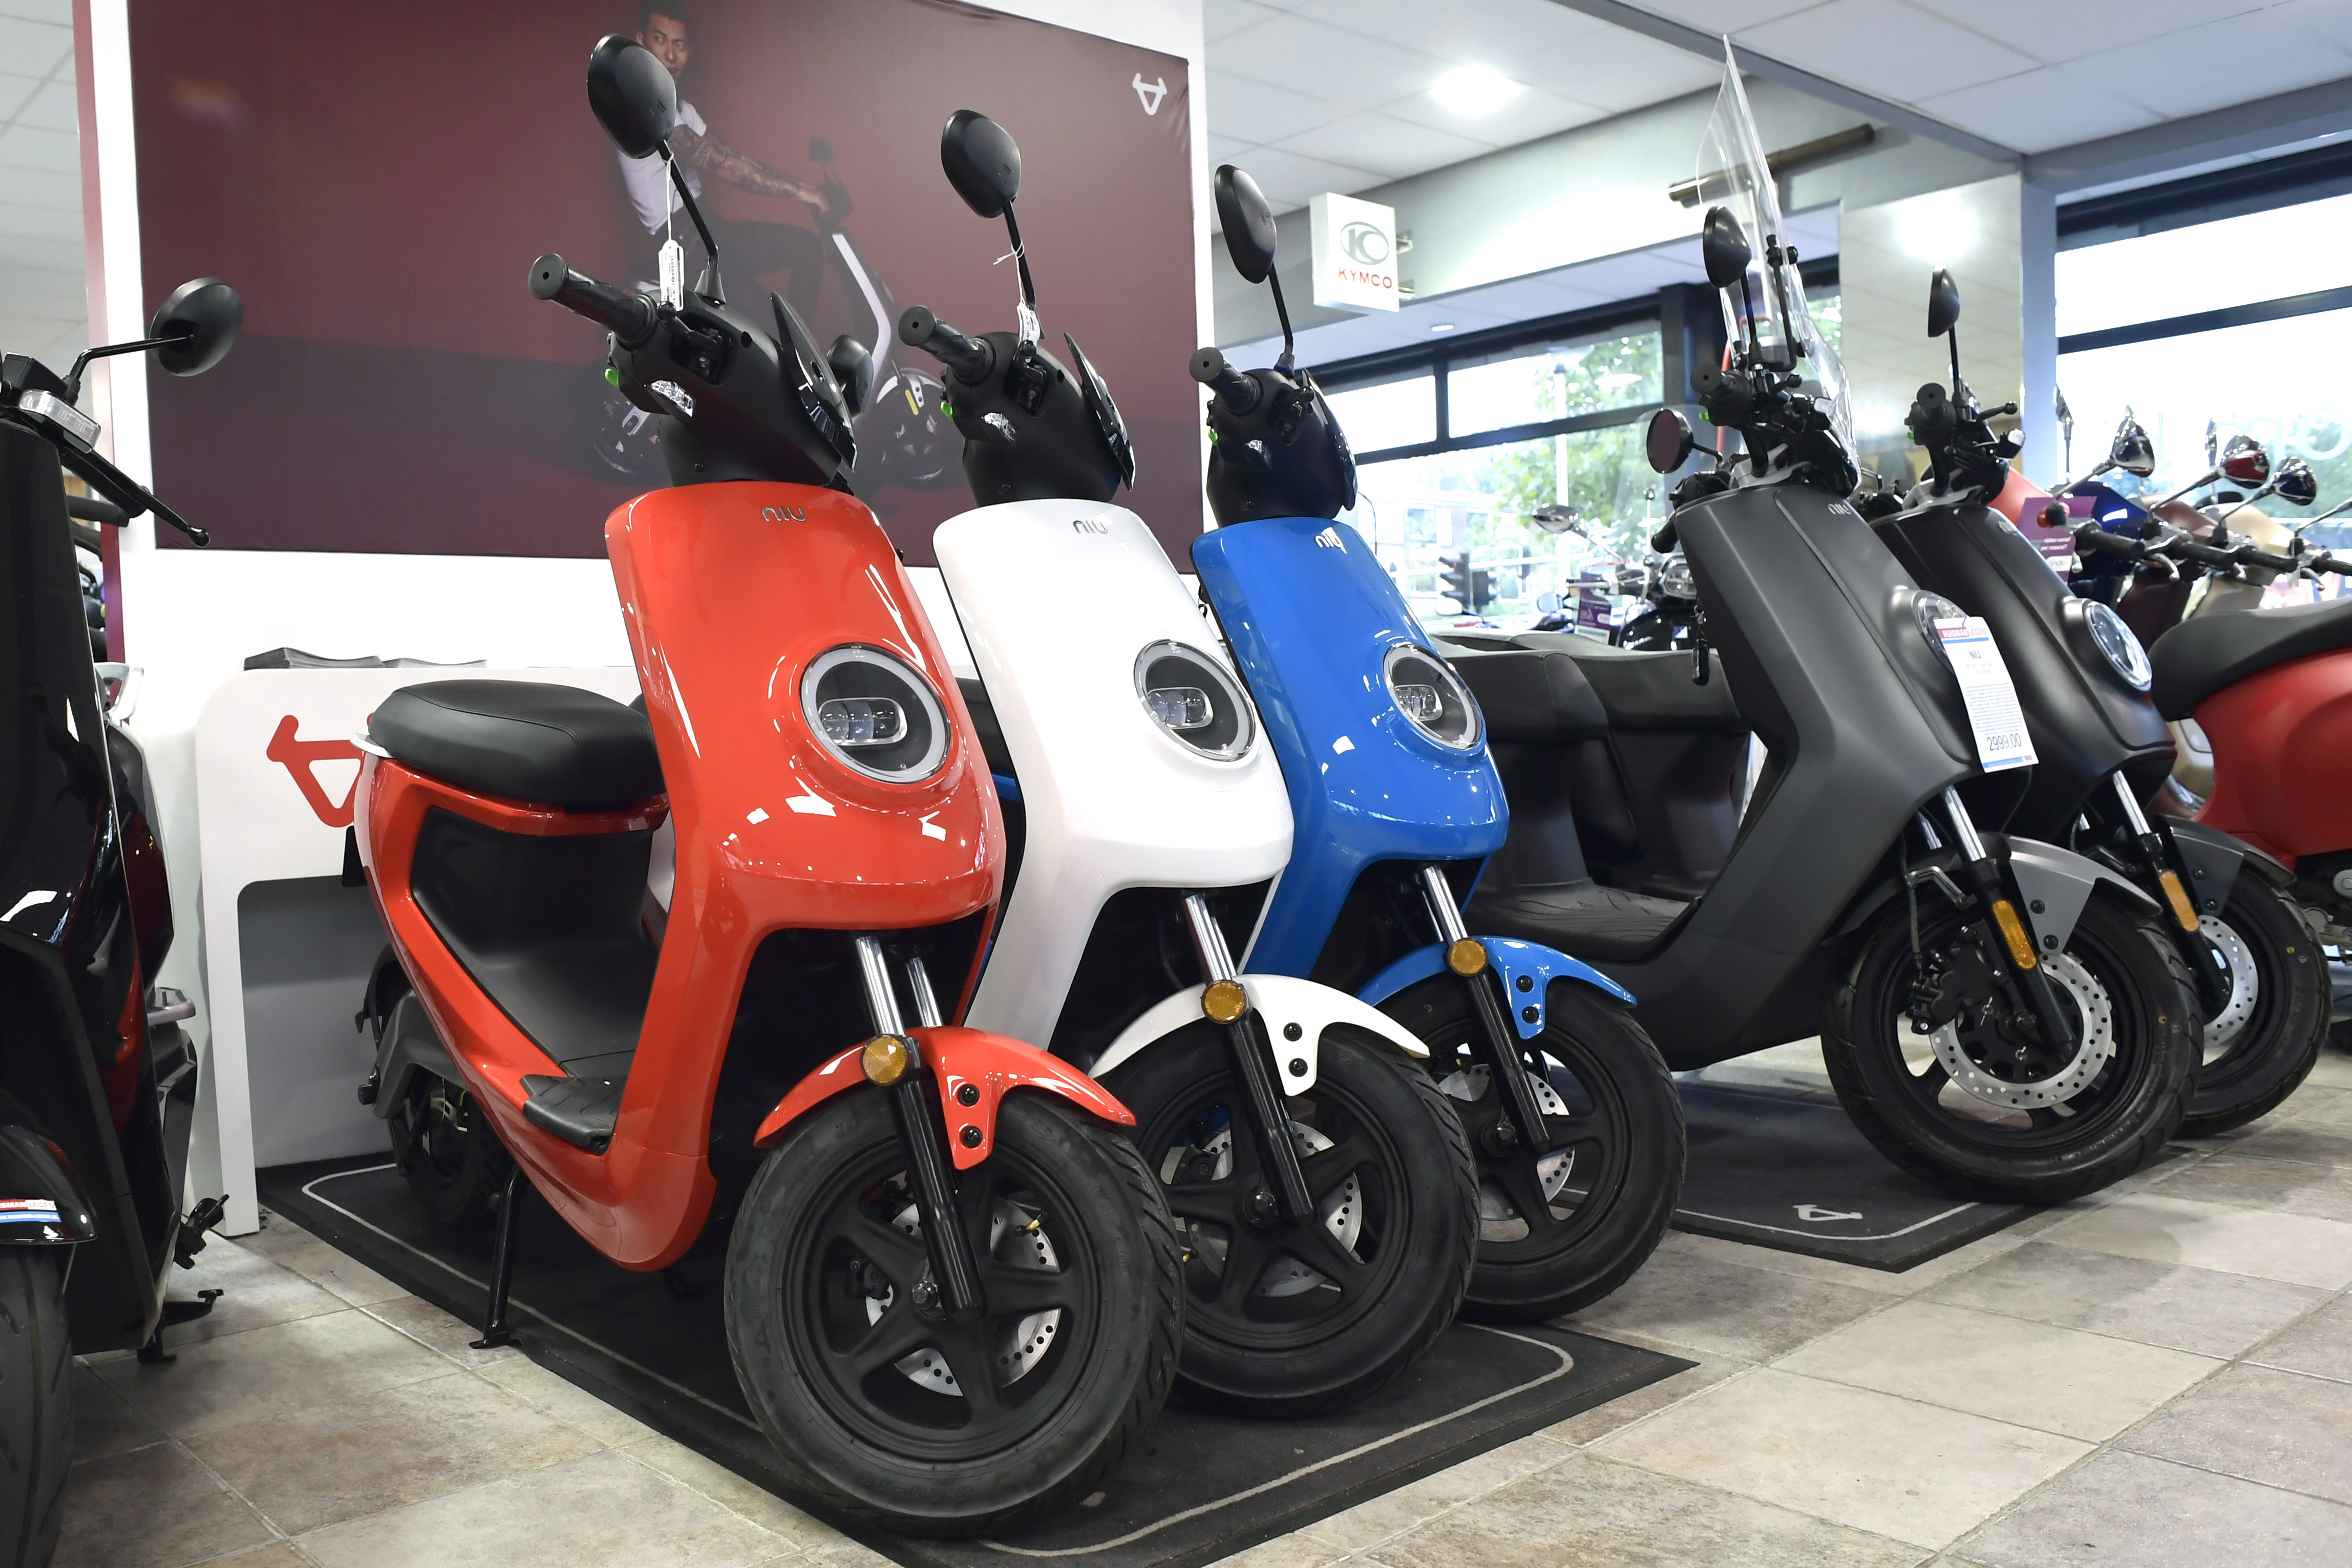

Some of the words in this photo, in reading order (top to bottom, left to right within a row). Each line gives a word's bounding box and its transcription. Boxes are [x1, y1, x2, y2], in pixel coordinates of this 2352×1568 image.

[1338, 267, 1392, 289] KYMCO
[1968, 628, 1986, 636] LEIDEN
[1969, 650, 1981, 659] NIU
[1987, 733, 2022, 751] 2999,00
